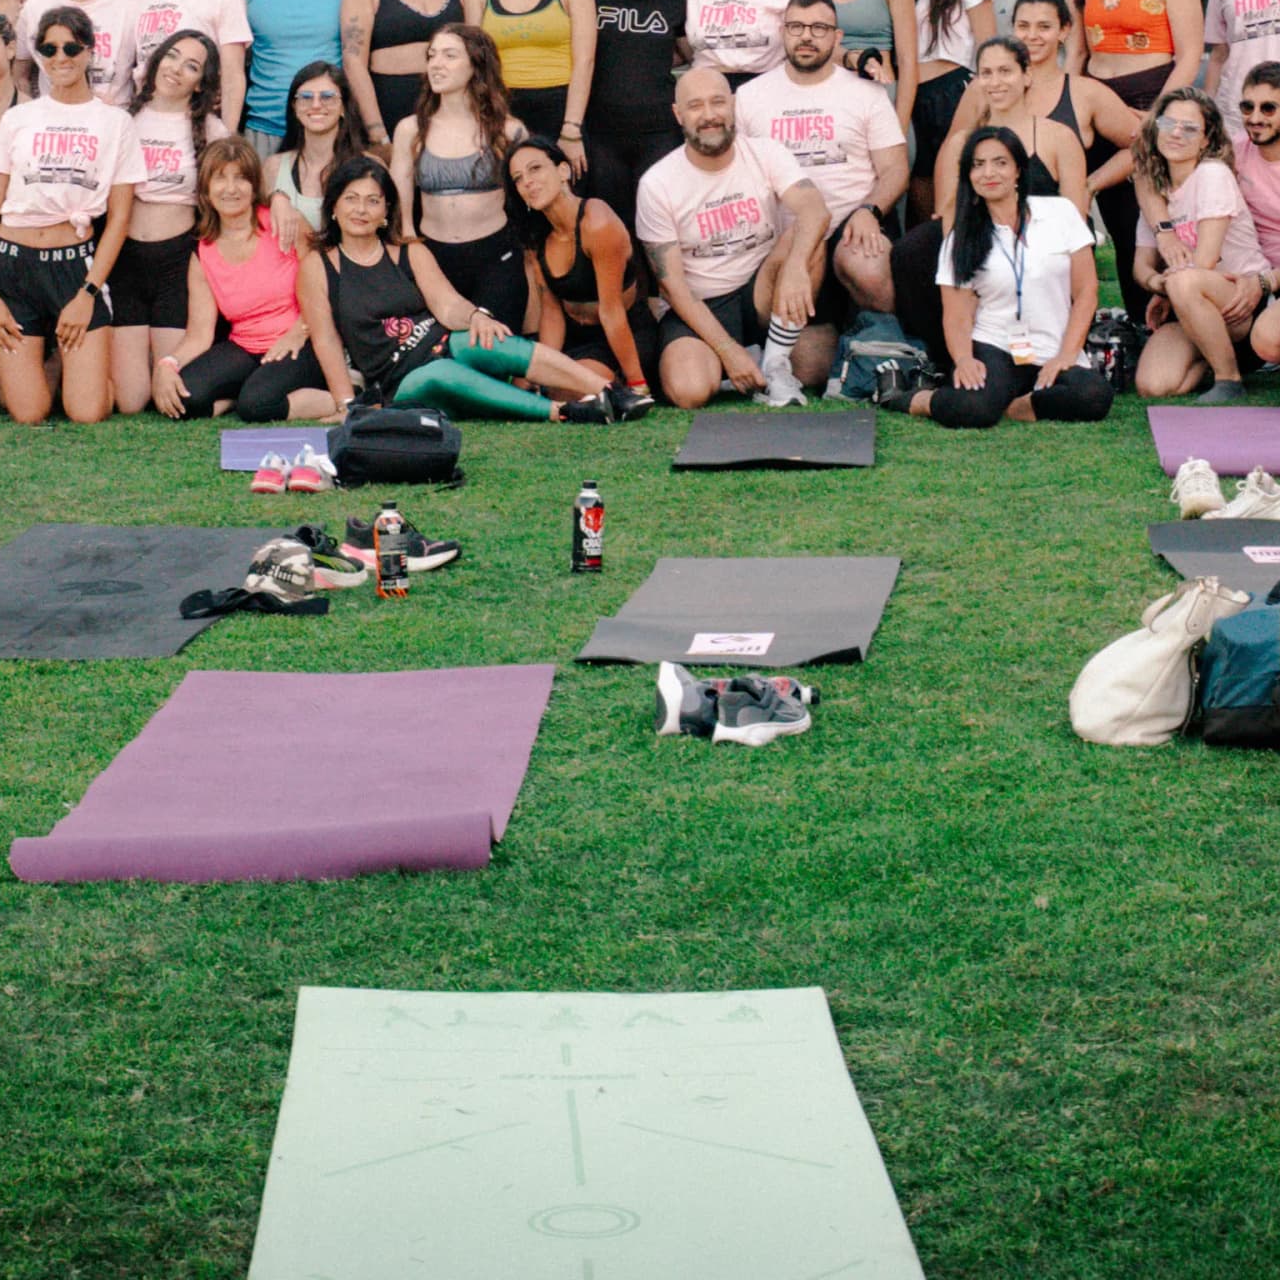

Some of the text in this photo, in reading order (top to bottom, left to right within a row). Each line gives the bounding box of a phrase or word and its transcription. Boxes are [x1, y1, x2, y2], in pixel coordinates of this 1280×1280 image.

[137, 9, 183, 34] FITNESS
[597, 5, 669, 34] FILA
[700, 4, 756, 28] FITNESS
[771, 114, 834, 143] FITNESS
[32, 132, 99, 162] FITNESS
[696, 197, 761, 241] FITNESS
